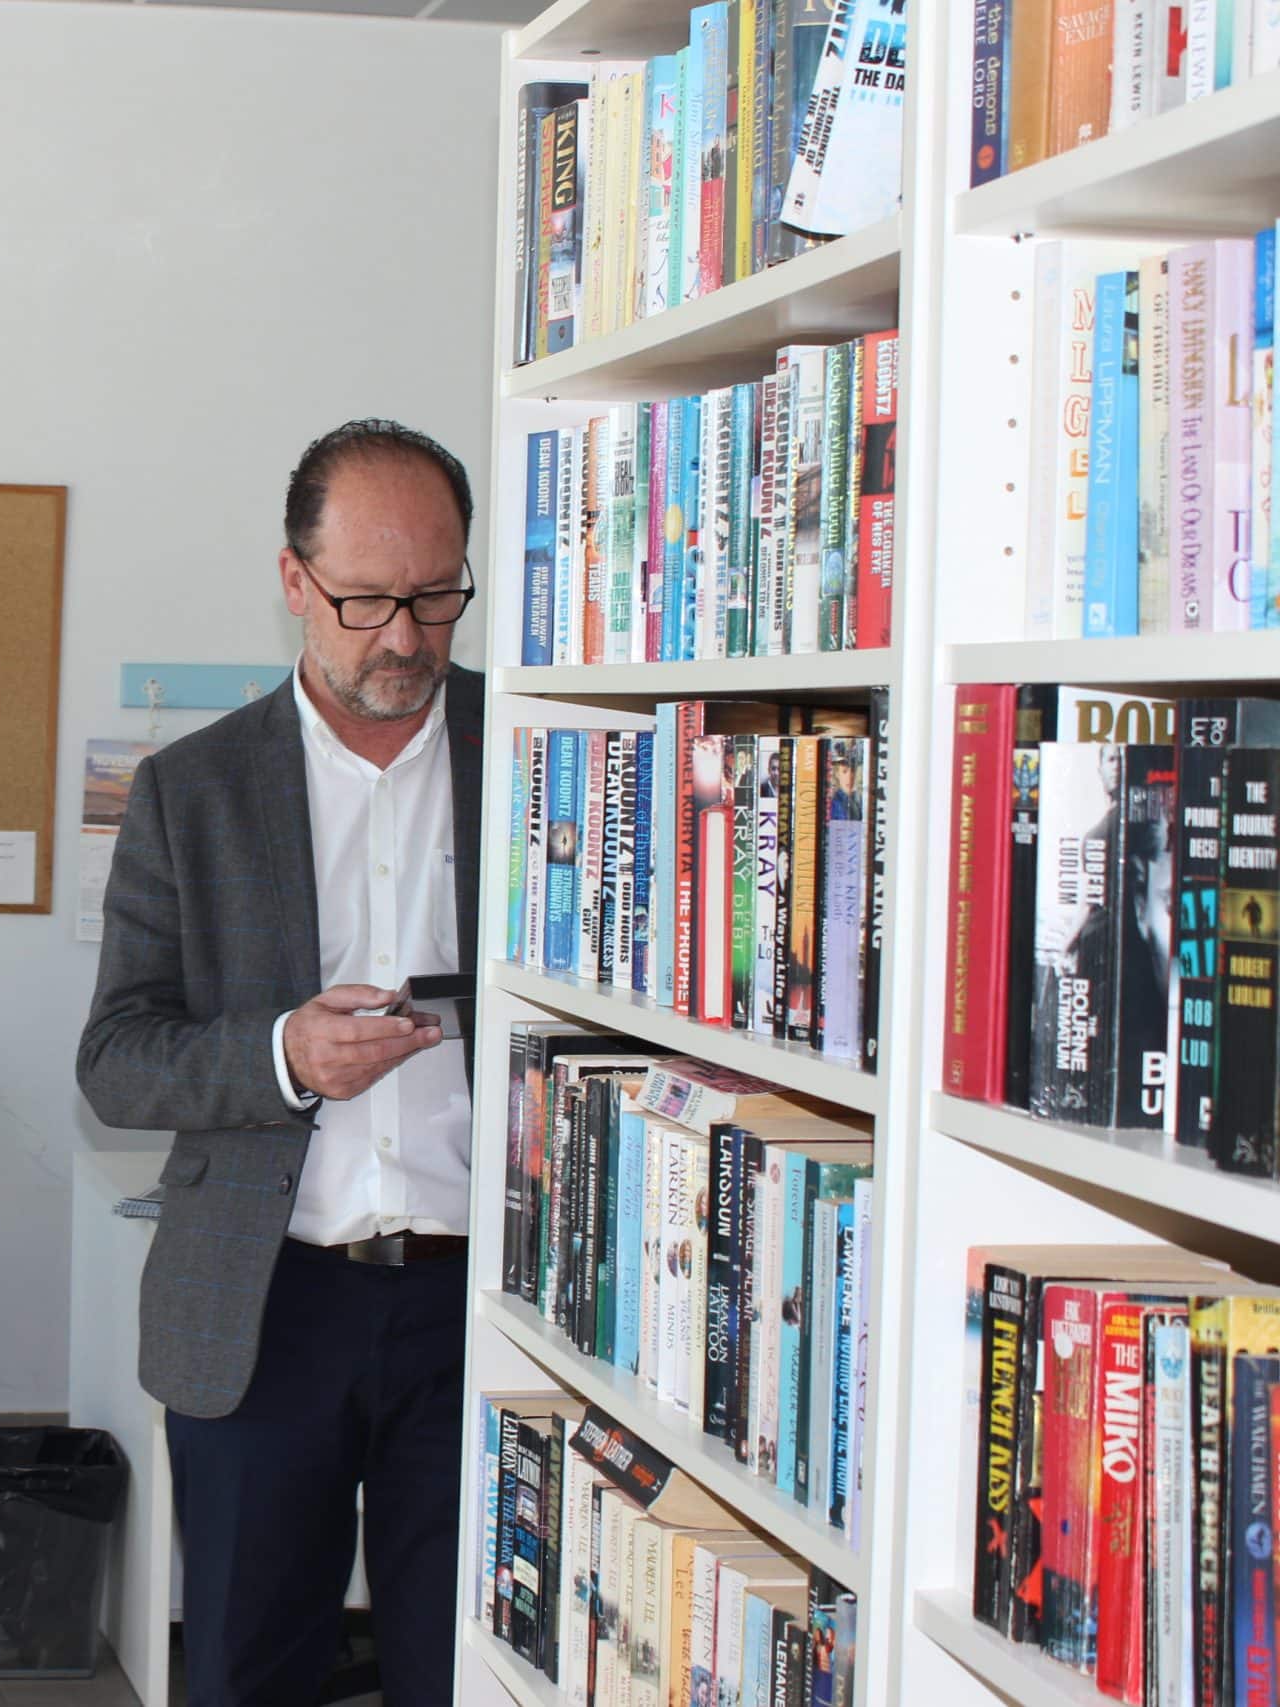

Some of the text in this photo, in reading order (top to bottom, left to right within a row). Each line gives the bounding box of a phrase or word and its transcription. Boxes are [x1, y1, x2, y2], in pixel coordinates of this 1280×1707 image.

[854, 68, 881, 87] THE
[974, 59, 986, 109] LORD
[985, 4, 1002, 136] the demons
[1131, 12, 1144, 112] KEVIN LEWIS
[555, 119, 576, 206] KING
[796, 93, 821, 158] THE YEAR
[804, 89, 831, 169] EVENING OF
[813, 86, 841, 177] THE DARKEST
[1180, 259, 1207, 410] NANCY LIVINGSTON
[875, 340, 892, 416] KOONTZ
[1095, 285, 1118, 485] Laura LIPPMAN
[536, 437, 552, 516] DEAN KOONTZ
[760, 382, 777, 541] DEAN KOONTZ
[774, 390, 790, 508] KOONTZ
[828, 353, 846, 545] KOONTZ Winter Moon
[539, 566, 548, 588] ONE
[870, 501, 883, 575] OF HIS EYE
[881, 501, 894, 589] THE CORNER
[530, 566, 541, 636] FROM HEAVEN
[773, 538, 785, 632] ODD HOURS
[537, 619, 547, 648] AWAY
[529, 750, 543, 847] KOONTZ
[558, 736, 574, 817] DEAN KOONTZ
[586, 742, 603, 880] DEAN KOONTZ
[607, 741, 620, 801] DEAN
[619, 752, 637, 856] KOONTZ
[1245, 781, 1267, 804] THE
[509, 812, 521, 889] NOTHING
[634, 739, 654, 897] KOONTZ of Thunder
[677, 703, 696, 1011] MICHAEL KORYTA THE PROPHET
[757, 810, 775, 897] KRAY
[1228, 846, 1277, 868] IDENTITY
[549, 867, 563, 923] HIGHWAYS
[562, 868, 572, 914] STRANGE
[732, 805, 750, 951] KRAY DEBT
[845, 831, 858, 926] ANNA KING
[952, 753, 976, 1035] THE AQUITAINE PROGRESSION
[1058, 837, 1079, 906] LUDLUM
[1084, 839, 1106, 907] ROBERT
[582, 908, 592, 935] GUY
[591, 889, 600, 954] THE GOOD
[619, 880, 632, 963] ODD HOURS
[776, 907, 788, 945] Way
[775, 963, 787, 998] Life
[1055, 977, 1072, 1070] ULTIMATUM
[1069, 979, 1089, 1072] BOURNE
[1086, 1016, 1098, 1038] THE
[588, 1134, 597, 1164] JOHN
[667, 1143, 681, 1226] LARKIN
[717, 1135, 734, 1236] LARSSON
[586, 1166, 595, 1235] LANCHESTER
[790, 1168, 803, 1224] Forever
[584, 1256, 593, 1302] PHILLIPS
[743, 1158, 759, 1321] THE SAVAGE ALTAR
[707, 1284, 720, 1362] TATTOO
[834, 1225, 857, 1497] LAWRENCE NOTHING LIKE THE NIGHT
[1112, 1343, 1138, 1367] THE
[989, 1319, 1018, 1437] FRENCH
[581, 1420, 609, 1453] STEPHEN
[1103, 1371, 1140, 1484] MIKO
[1249, 1404, 1267, 1515] WATCHMEN
[500, 1416, 519, 1564] LAYMON IN THE DARK
[987, 1442, 1013, 1515] KISS
[1199, 1360, 1222, 1592] DEATH FORCE
[644, 1540, 659, 1624] MAUREEN LEE
[675, 1568, 688, 1599] Lee
[692, 1592, 704, 1625] LEE
[703, 1564, 714, 1661] MAUREEN
[774, 1640, 788, 1707] LEHANE
